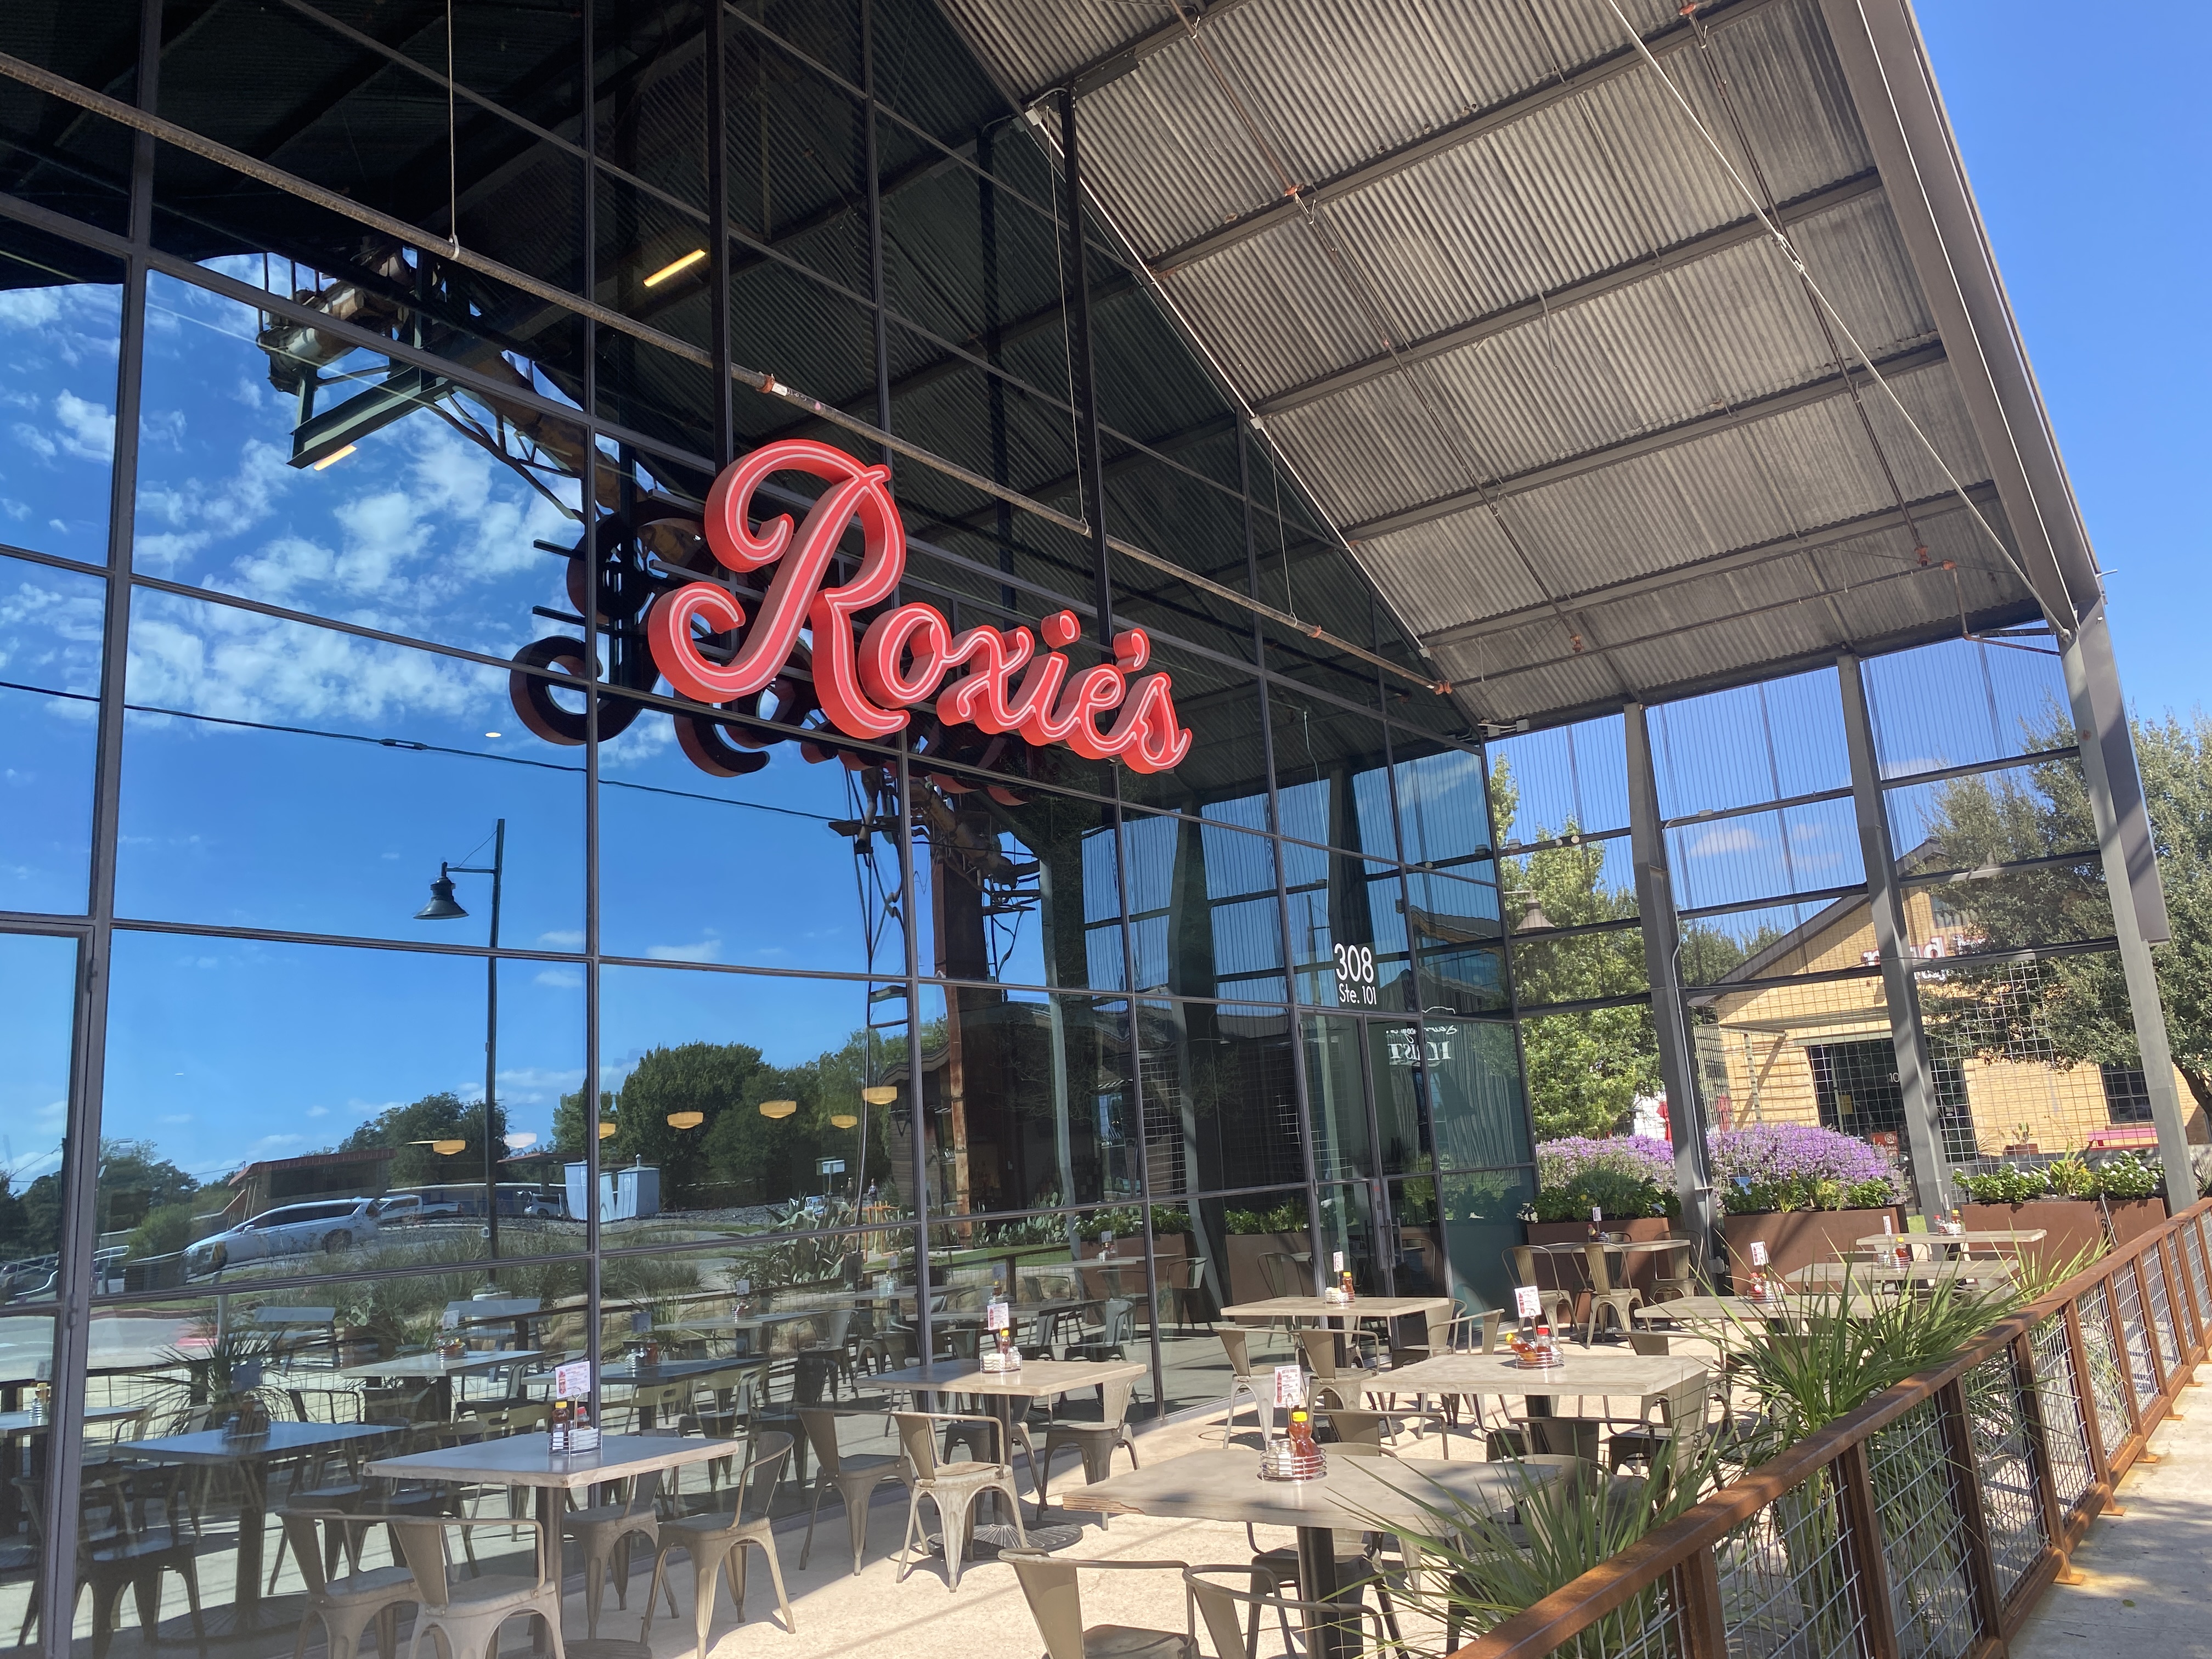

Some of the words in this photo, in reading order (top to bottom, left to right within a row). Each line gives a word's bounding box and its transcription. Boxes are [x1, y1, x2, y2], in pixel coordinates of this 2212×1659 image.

[648, 439, 1193, 774] Roxie's
[1334, 943, 1374, 983] 308
[1339, 983, 1360, 1003] Ste.
[1362, 985, 1376, 1005] 101
